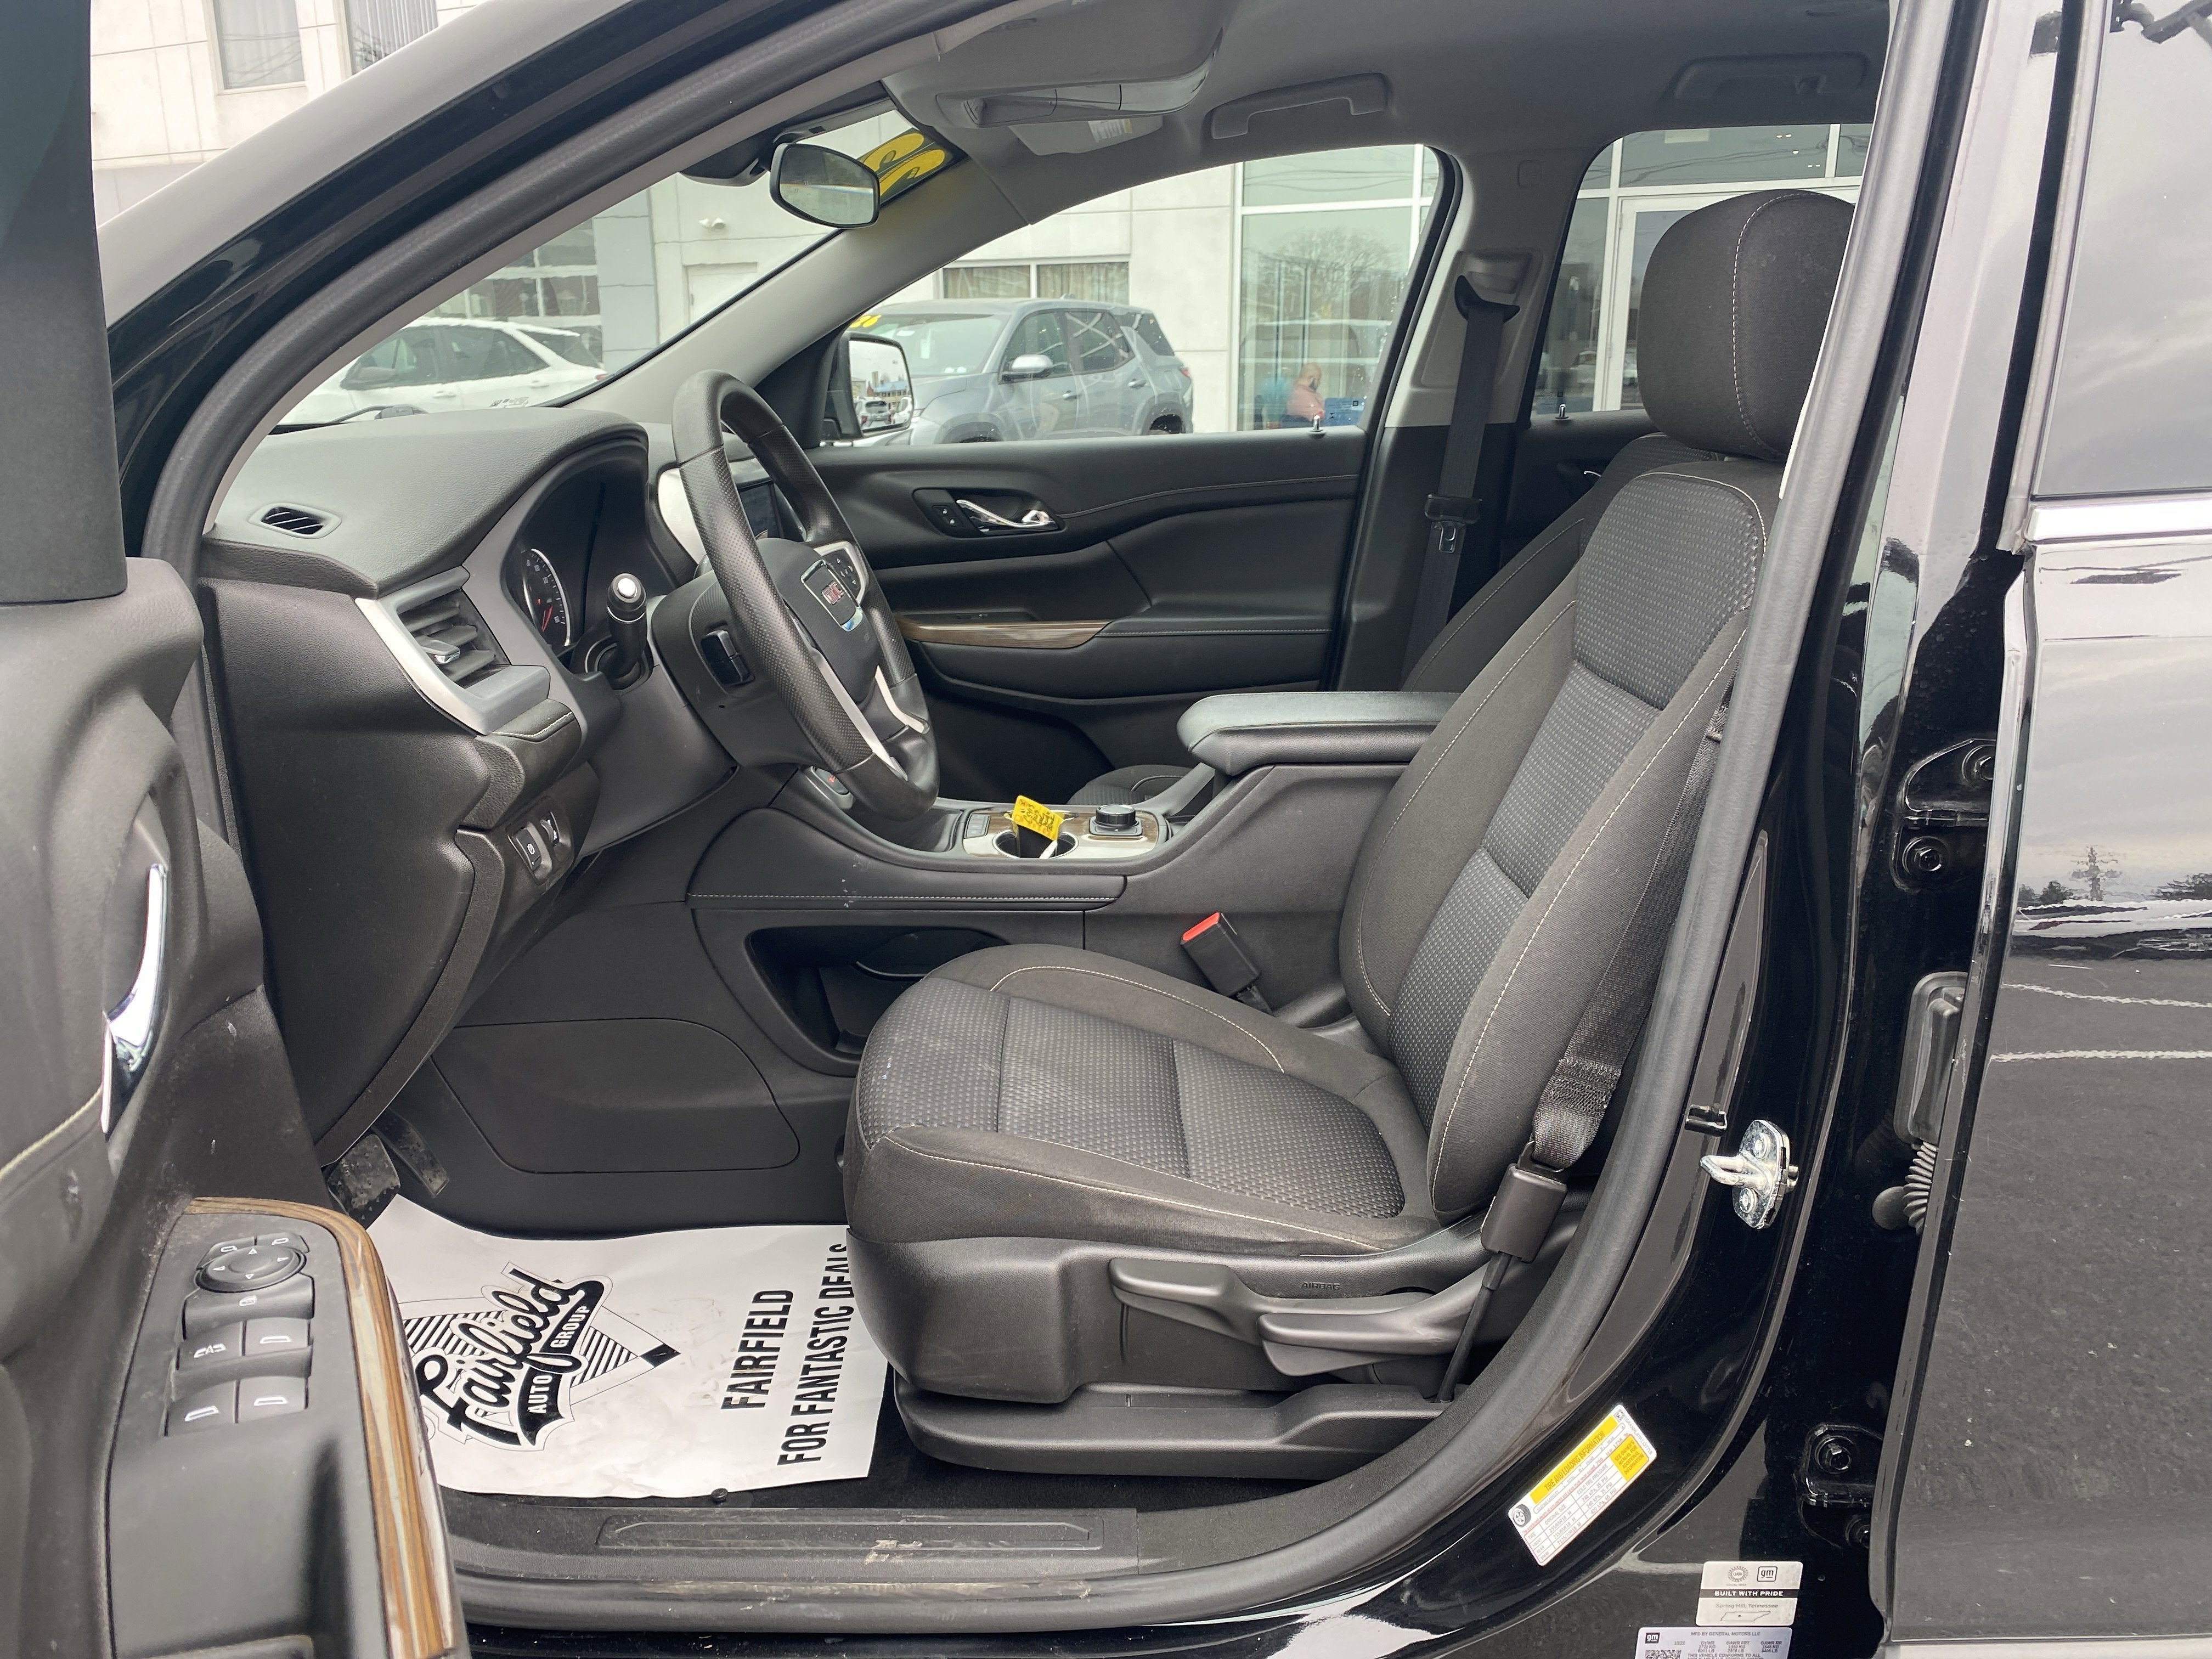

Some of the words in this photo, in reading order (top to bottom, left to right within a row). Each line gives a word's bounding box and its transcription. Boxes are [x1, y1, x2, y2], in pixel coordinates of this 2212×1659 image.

[821, 580, 844, 605] GMC
[415, 1268, 582, 1446] Fairfield
[527, 1375, 552, 1414] AUTO
[550, 1305, 590, 1348] GROUP
[720, 1289, 794, 1409] FAIRFIELD
[791, 1306, 854, 1416] FANTASTIC
[777, 1421, 831, 1465] FOR
[1543, 1478, 1556, 1492] TIRE
[1553, 1470, 1564, 1483] AND
[1561, 1454, 1581, 1475] LOADING
[1577, 1430, 1606, 1459] INFORMATION
[1617, 1451, 1632, 1466] MANUAL
[1621, 1449, 1640, 1469] ADDITIONAL
[1623, 1453, 1645, 1475] INFORMATION
[1527, 1531, 1536, 1541] TIRE
[1544, 1510, 1559, 1526] ORIGINAL
[1576, 1484, 1586, 1496] COLD
[1591, 1463, 1609, 1481] PRESSURE
[1761, 1570, 1774, 1578] gm
